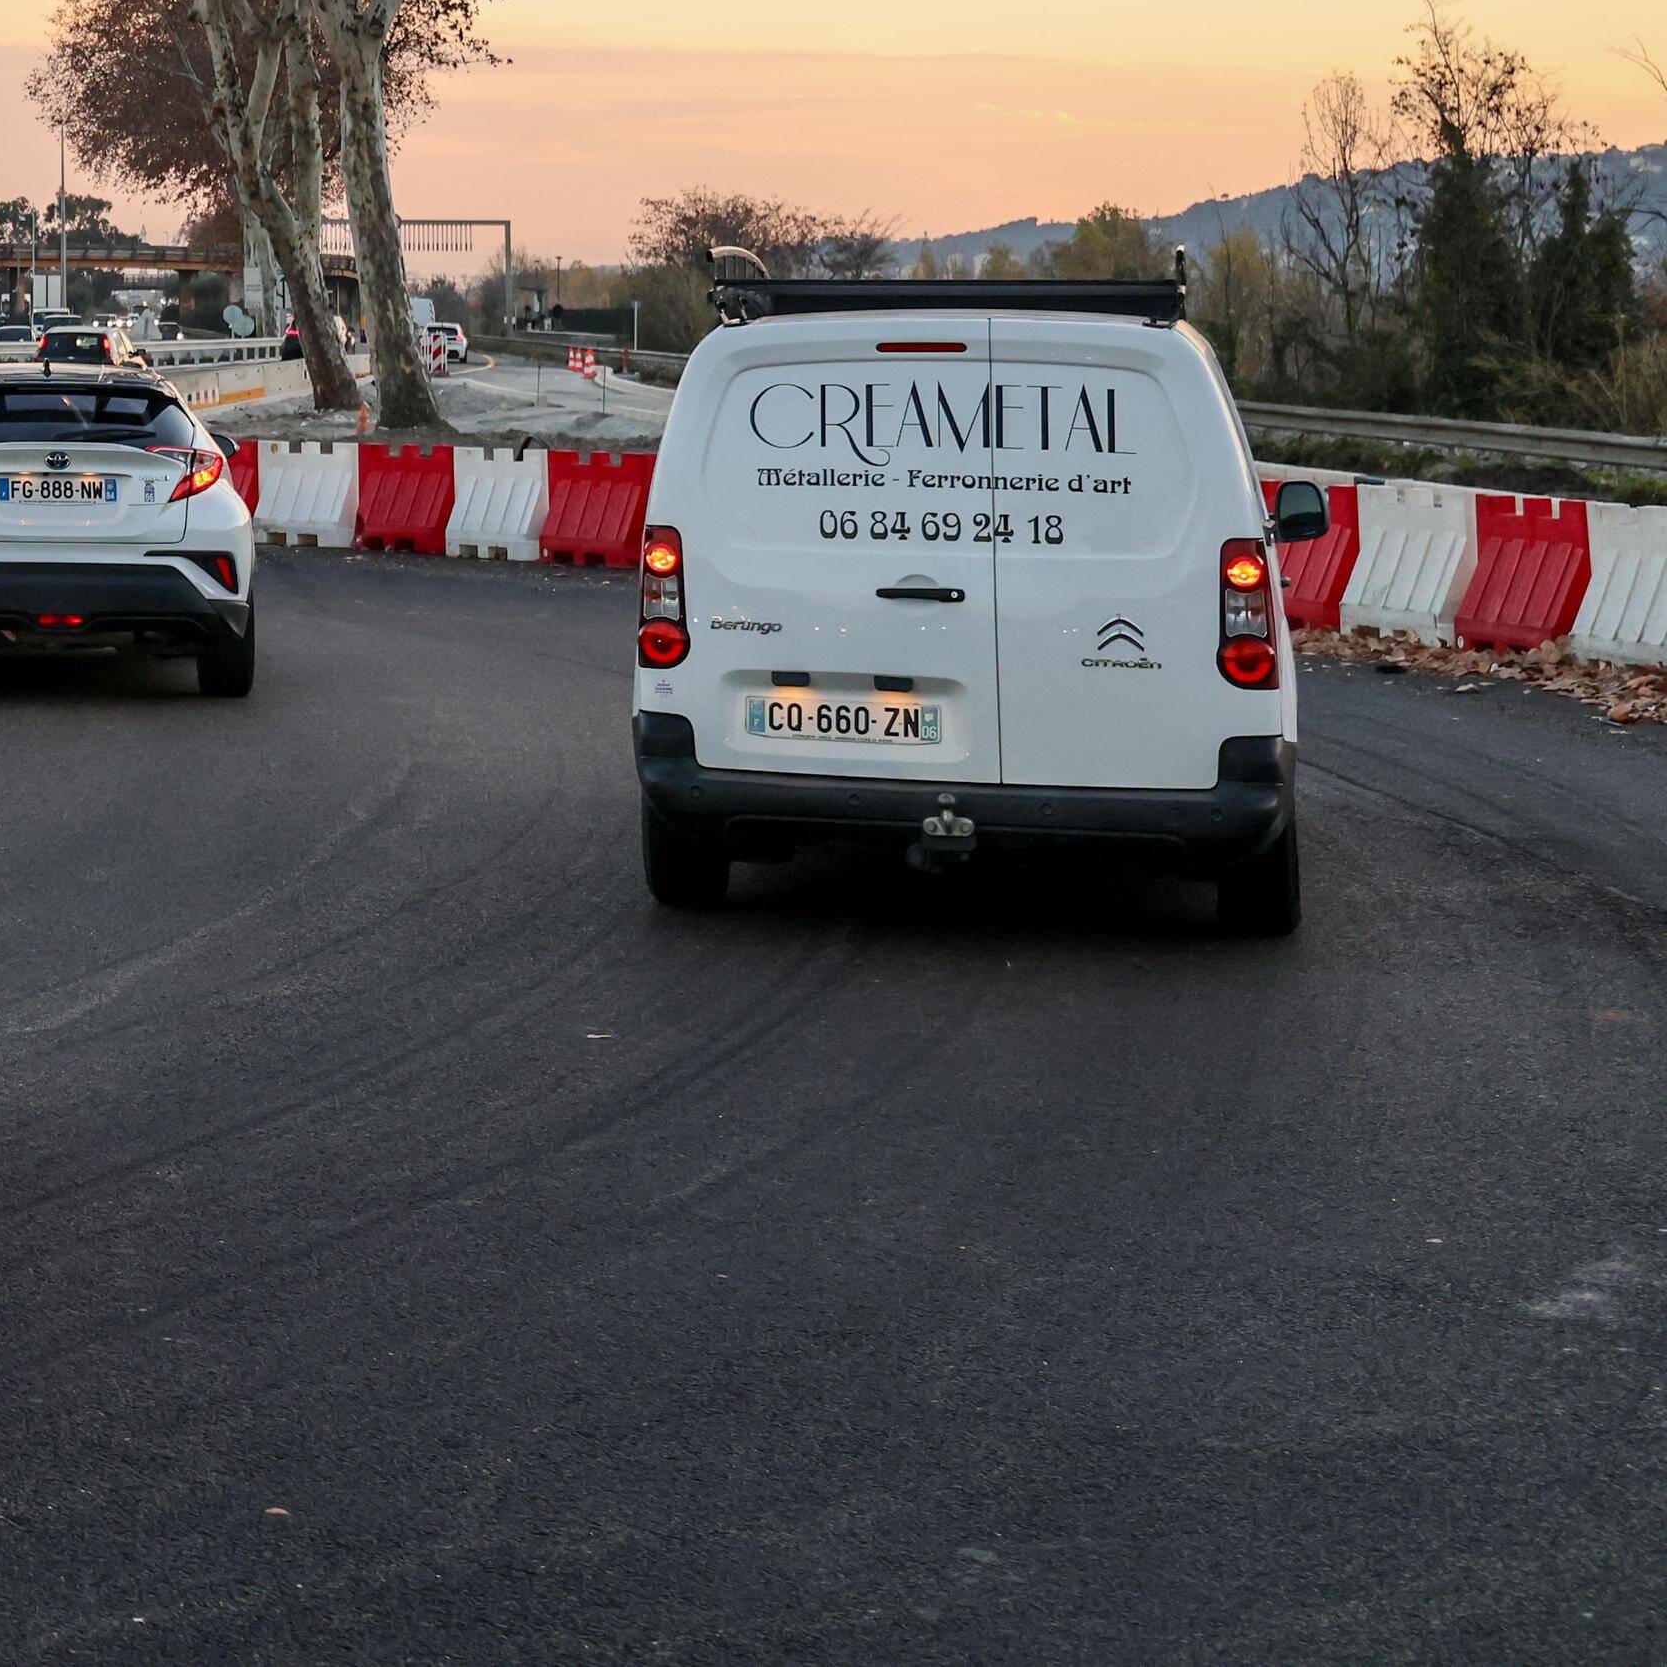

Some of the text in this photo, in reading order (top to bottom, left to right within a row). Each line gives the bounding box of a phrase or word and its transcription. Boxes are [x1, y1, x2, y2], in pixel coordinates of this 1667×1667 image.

[750, 379, 1137, 466] CREAMETAL
[11, 480, 103, 499] FG-888-NW
[758, 468, 885, 487] Métallerie
[908, 469, 1059, 492] Ferronnerie
[1068, 474, 1131, 494] d'art
[820, 510, 1064, 545] 06 84 69 24 18
[710, 616, 783, 635] Berlingo
[769, 702, 919, 738] CQ-660-ZN
[922, 725, 937, 740] 06
